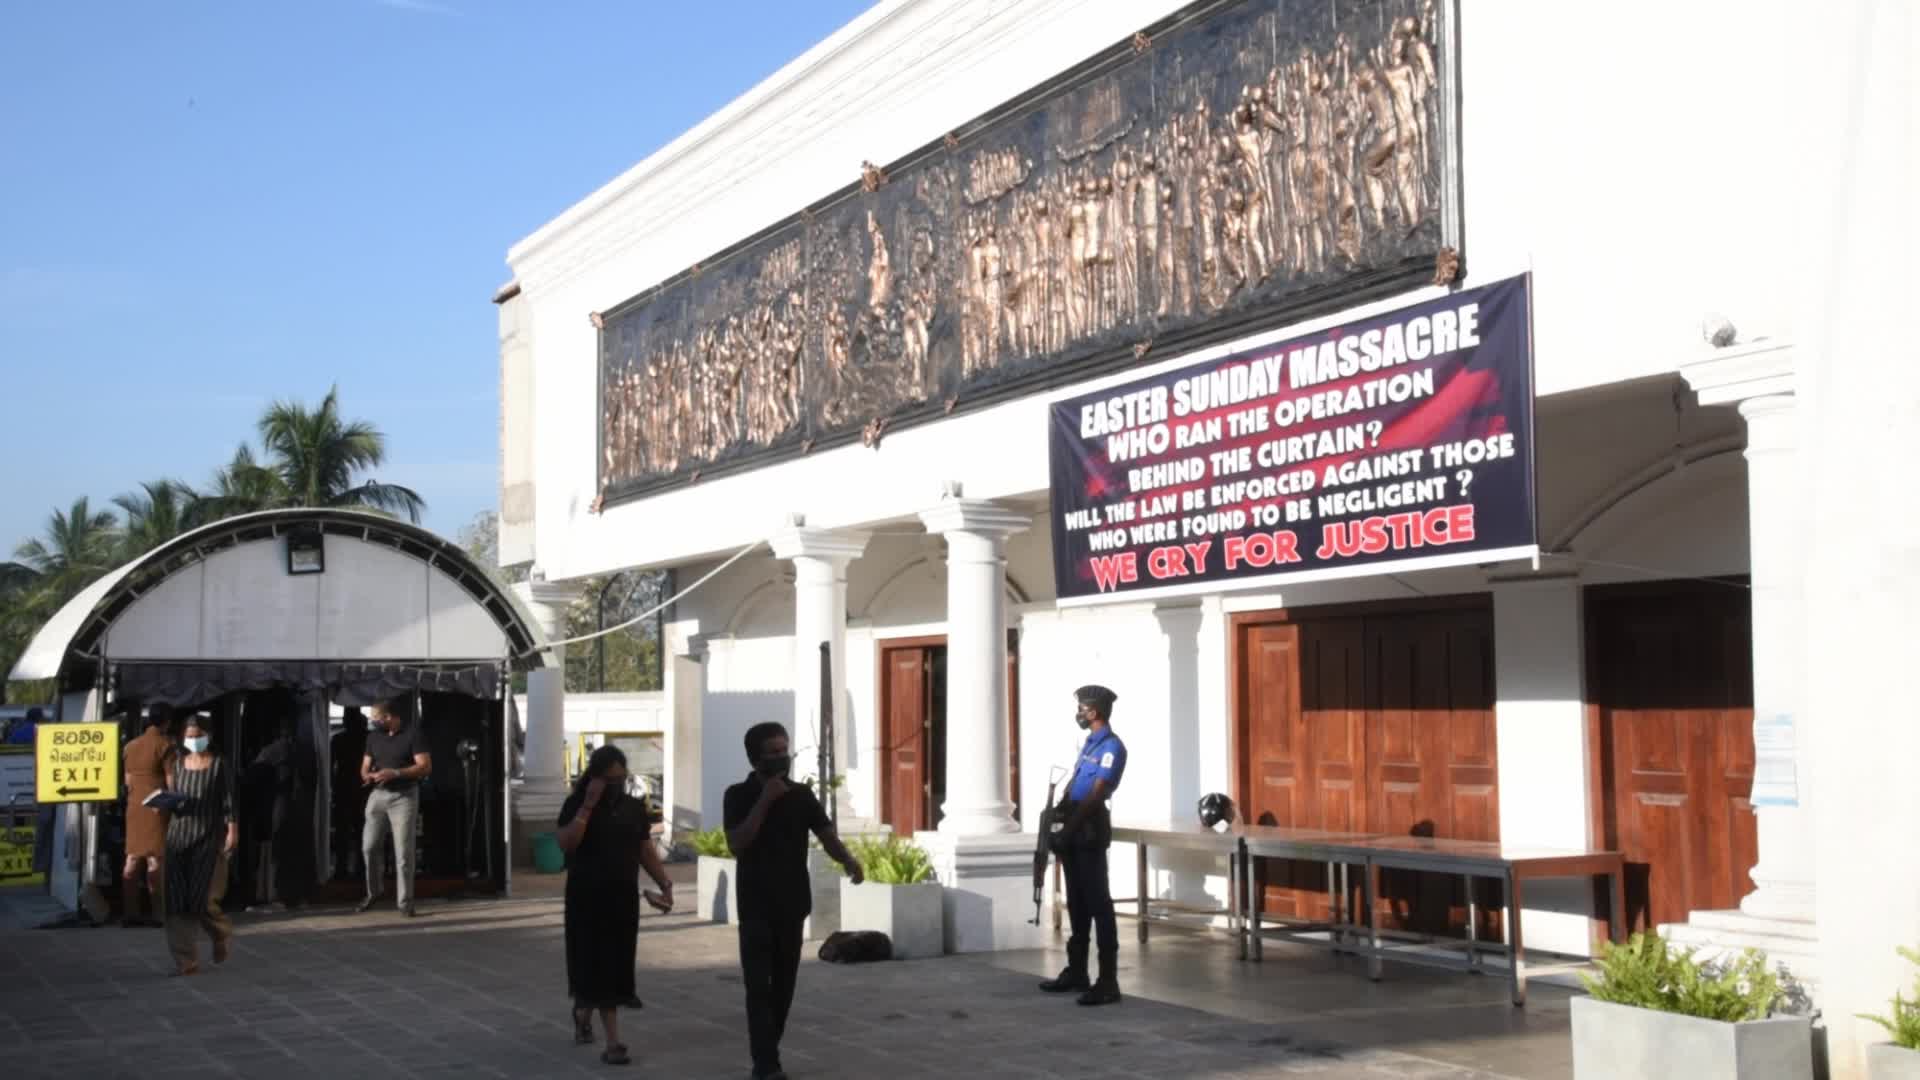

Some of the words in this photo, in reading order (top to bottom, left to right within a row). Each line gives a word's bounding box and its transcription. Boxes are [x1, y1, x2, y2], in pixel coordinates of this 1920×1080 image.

[1080, 385, 1168, 439] EASTER
[1173, 354, 1283, 416] SUNDAY
[1289, 303, 1480, 389] MASSACRE
[1107, 423, 1170, 463] WHO
[1175, 417, 1222, 449] RAN
[1227, 406, 1269, 438] THE
[1274, 368, 1434, 427] OPERATION
[1128, 457, 1205, 492] BEHIND
[1210, 447, 1251, 477] THE
[1257, 420, 1383, 467] CURTAIN?
[1065, 508, 1101, 531] WILL
[1105, 502, 1135, 524] THE
[1140, 494, 1177, 518] LAW
[1182, 489, 1205, 511] BE
[1211, 469, 1315, 506] ENFORCED
[1322, 449, 1424, 488] AGAINST
[1430, 433, 1515, 469] THOSE
[1088, 531, 1127, 551] WHO
[1130, 520, 1177, 545] WERE
[1182, 510, 1246, 537] FOUND
[1251, 504, 1280, 527] TO
[1285, 498, 1312, 522] BE
[1318, 476, 1447, 517] NEGLIGENT
[1456, 469, 1473, 497] ?
[1090, 552, 1138, 592] WE
[1147, 541, 1212, 579] CRY
[1224, 530, 1302, 570] FOR
[1316, 504, 1475, 559] JUSTICE
[50, 747, 106, 762] வெளியே
[53, 767, 102, 782] EXIT
[0, 857, 32, 870] XIT
